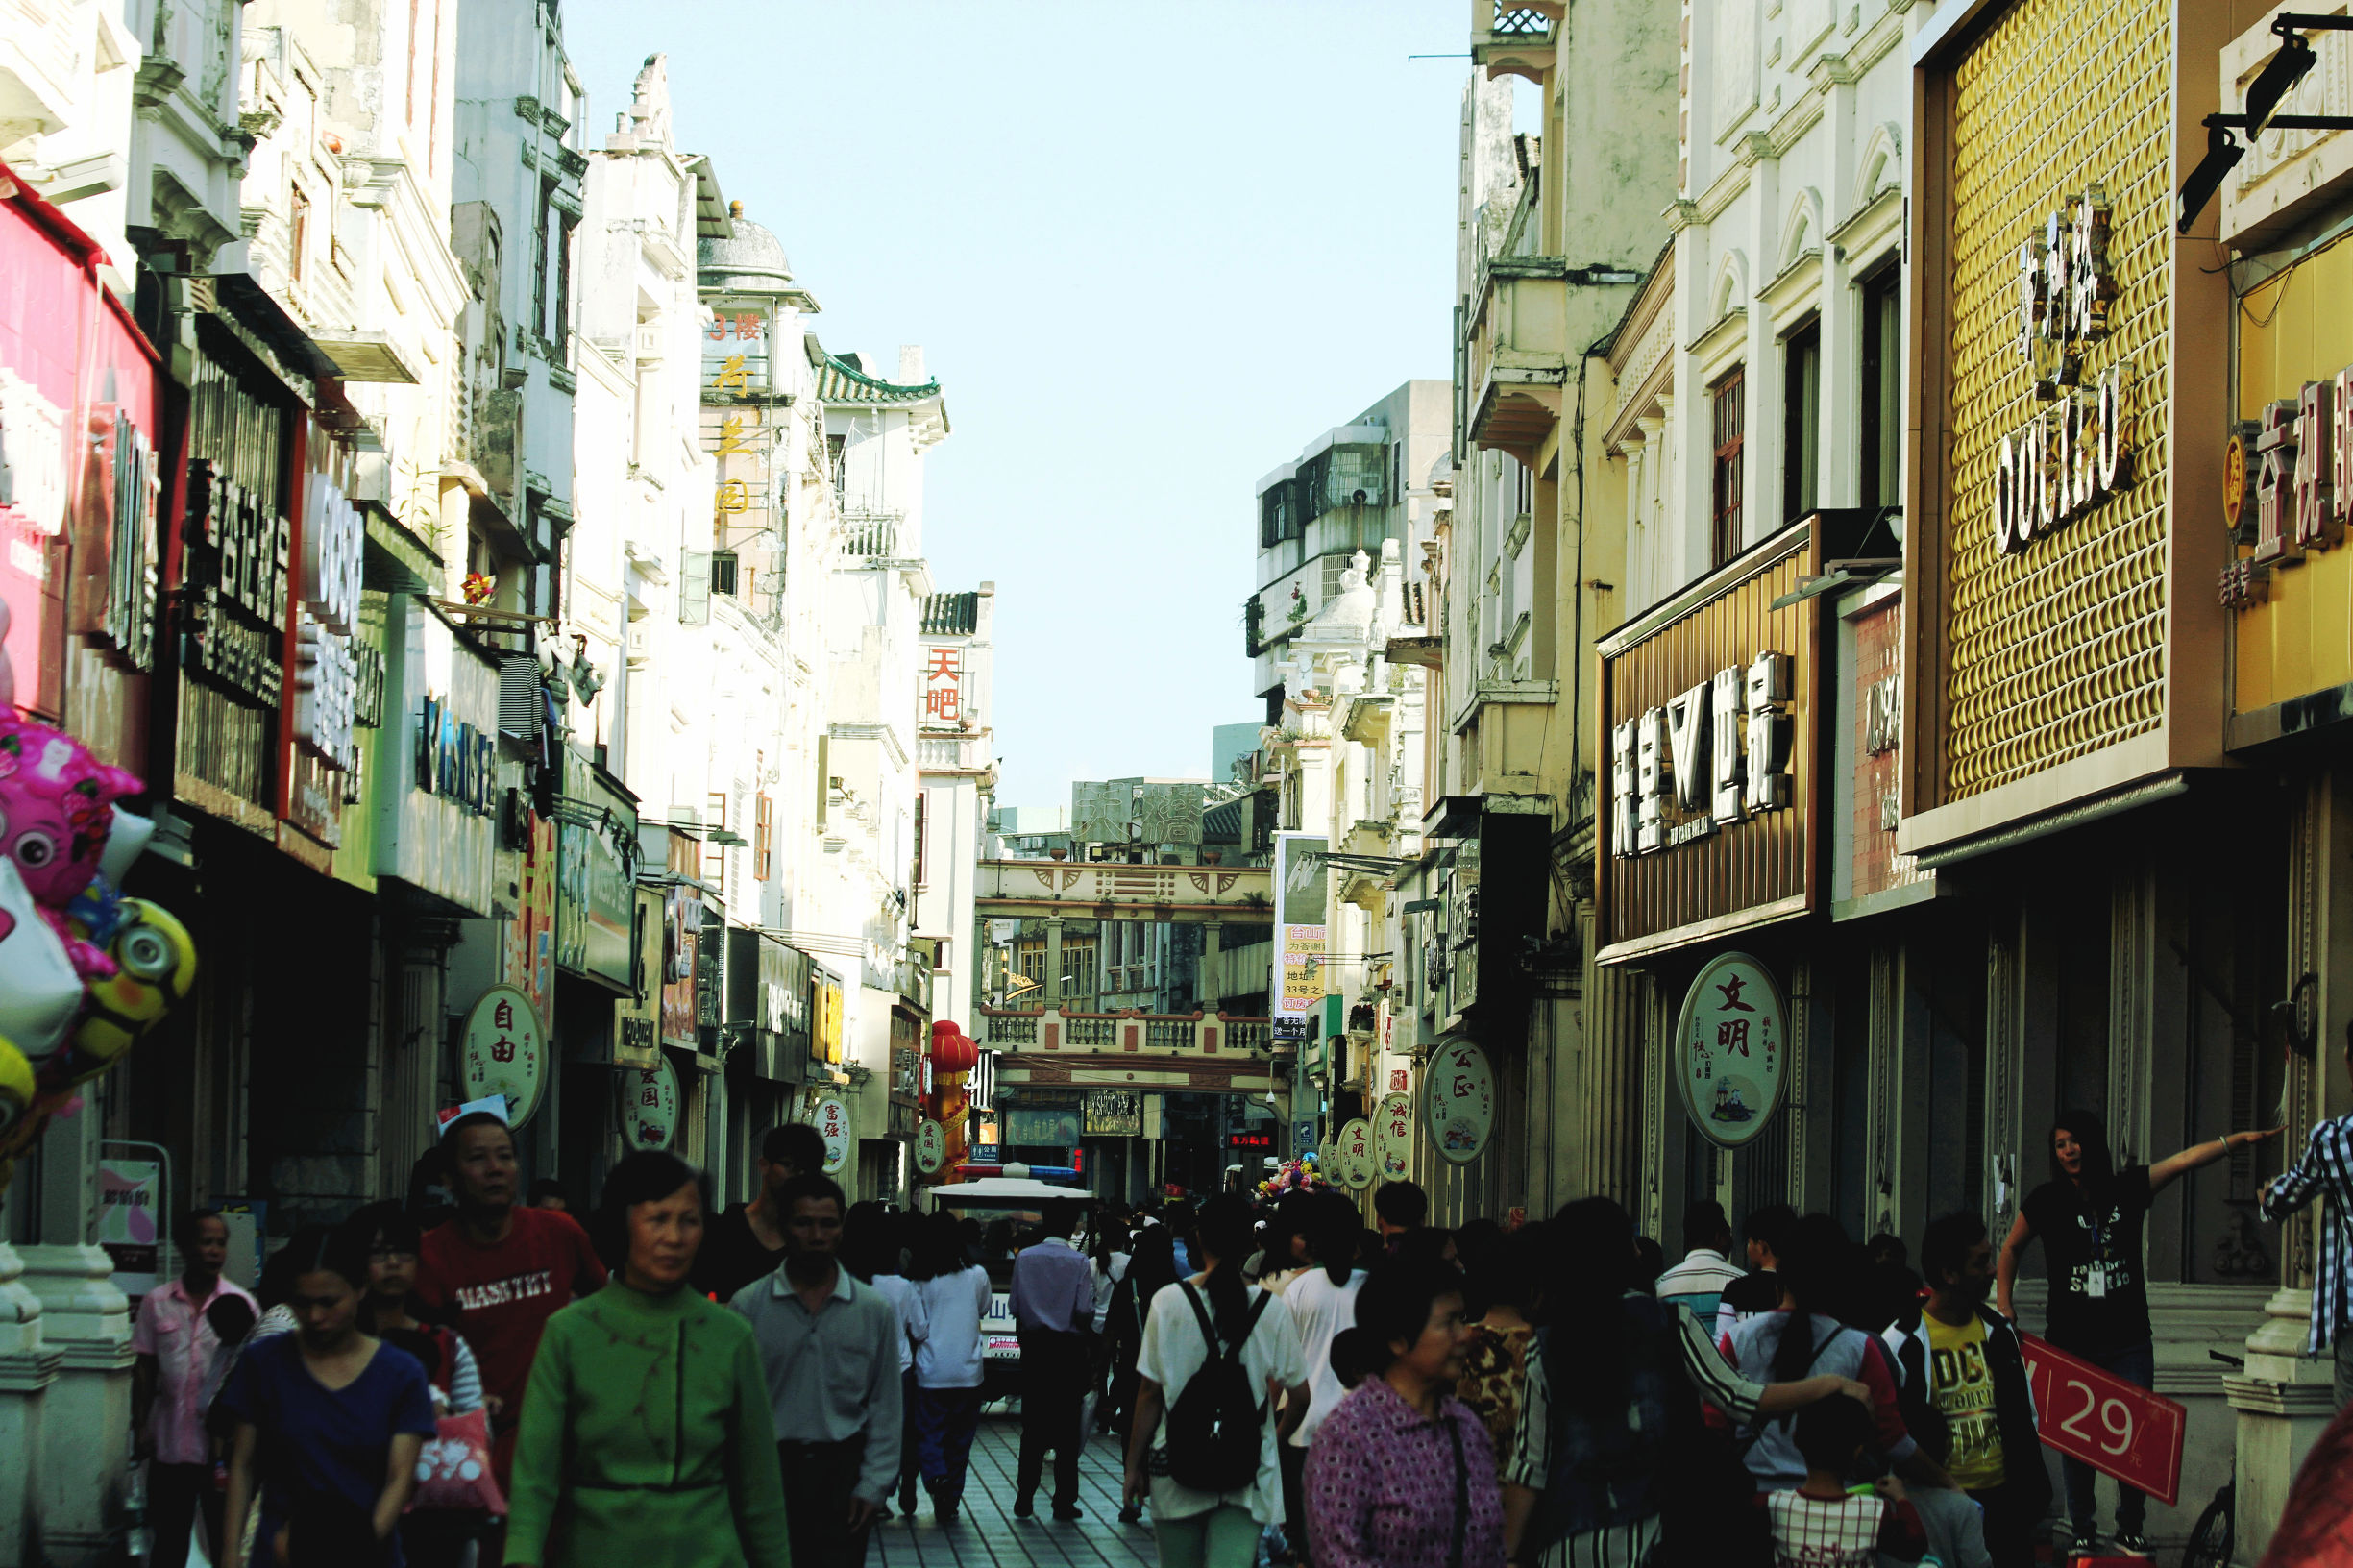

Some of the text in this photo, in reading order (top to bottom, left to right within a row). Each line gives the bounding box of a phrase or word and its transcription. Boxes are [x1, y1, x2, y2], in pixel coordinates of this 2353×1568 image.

[709, 313, 761, 340] 3楼
[926, 649, 961, 721] 天吧
[490, 997, 516, 1063] 自由
[1716, 972, 1756, 1058] 文明
[1450, 1049, 1476, 1098] 公正
[824, 1104, 840, 1138] 富强
[923, 1124, 934, 1149] 爱国
[1390, 1102, 1407, 1138] 诚信
[1352, 1126, 1366, 1158] 文明
